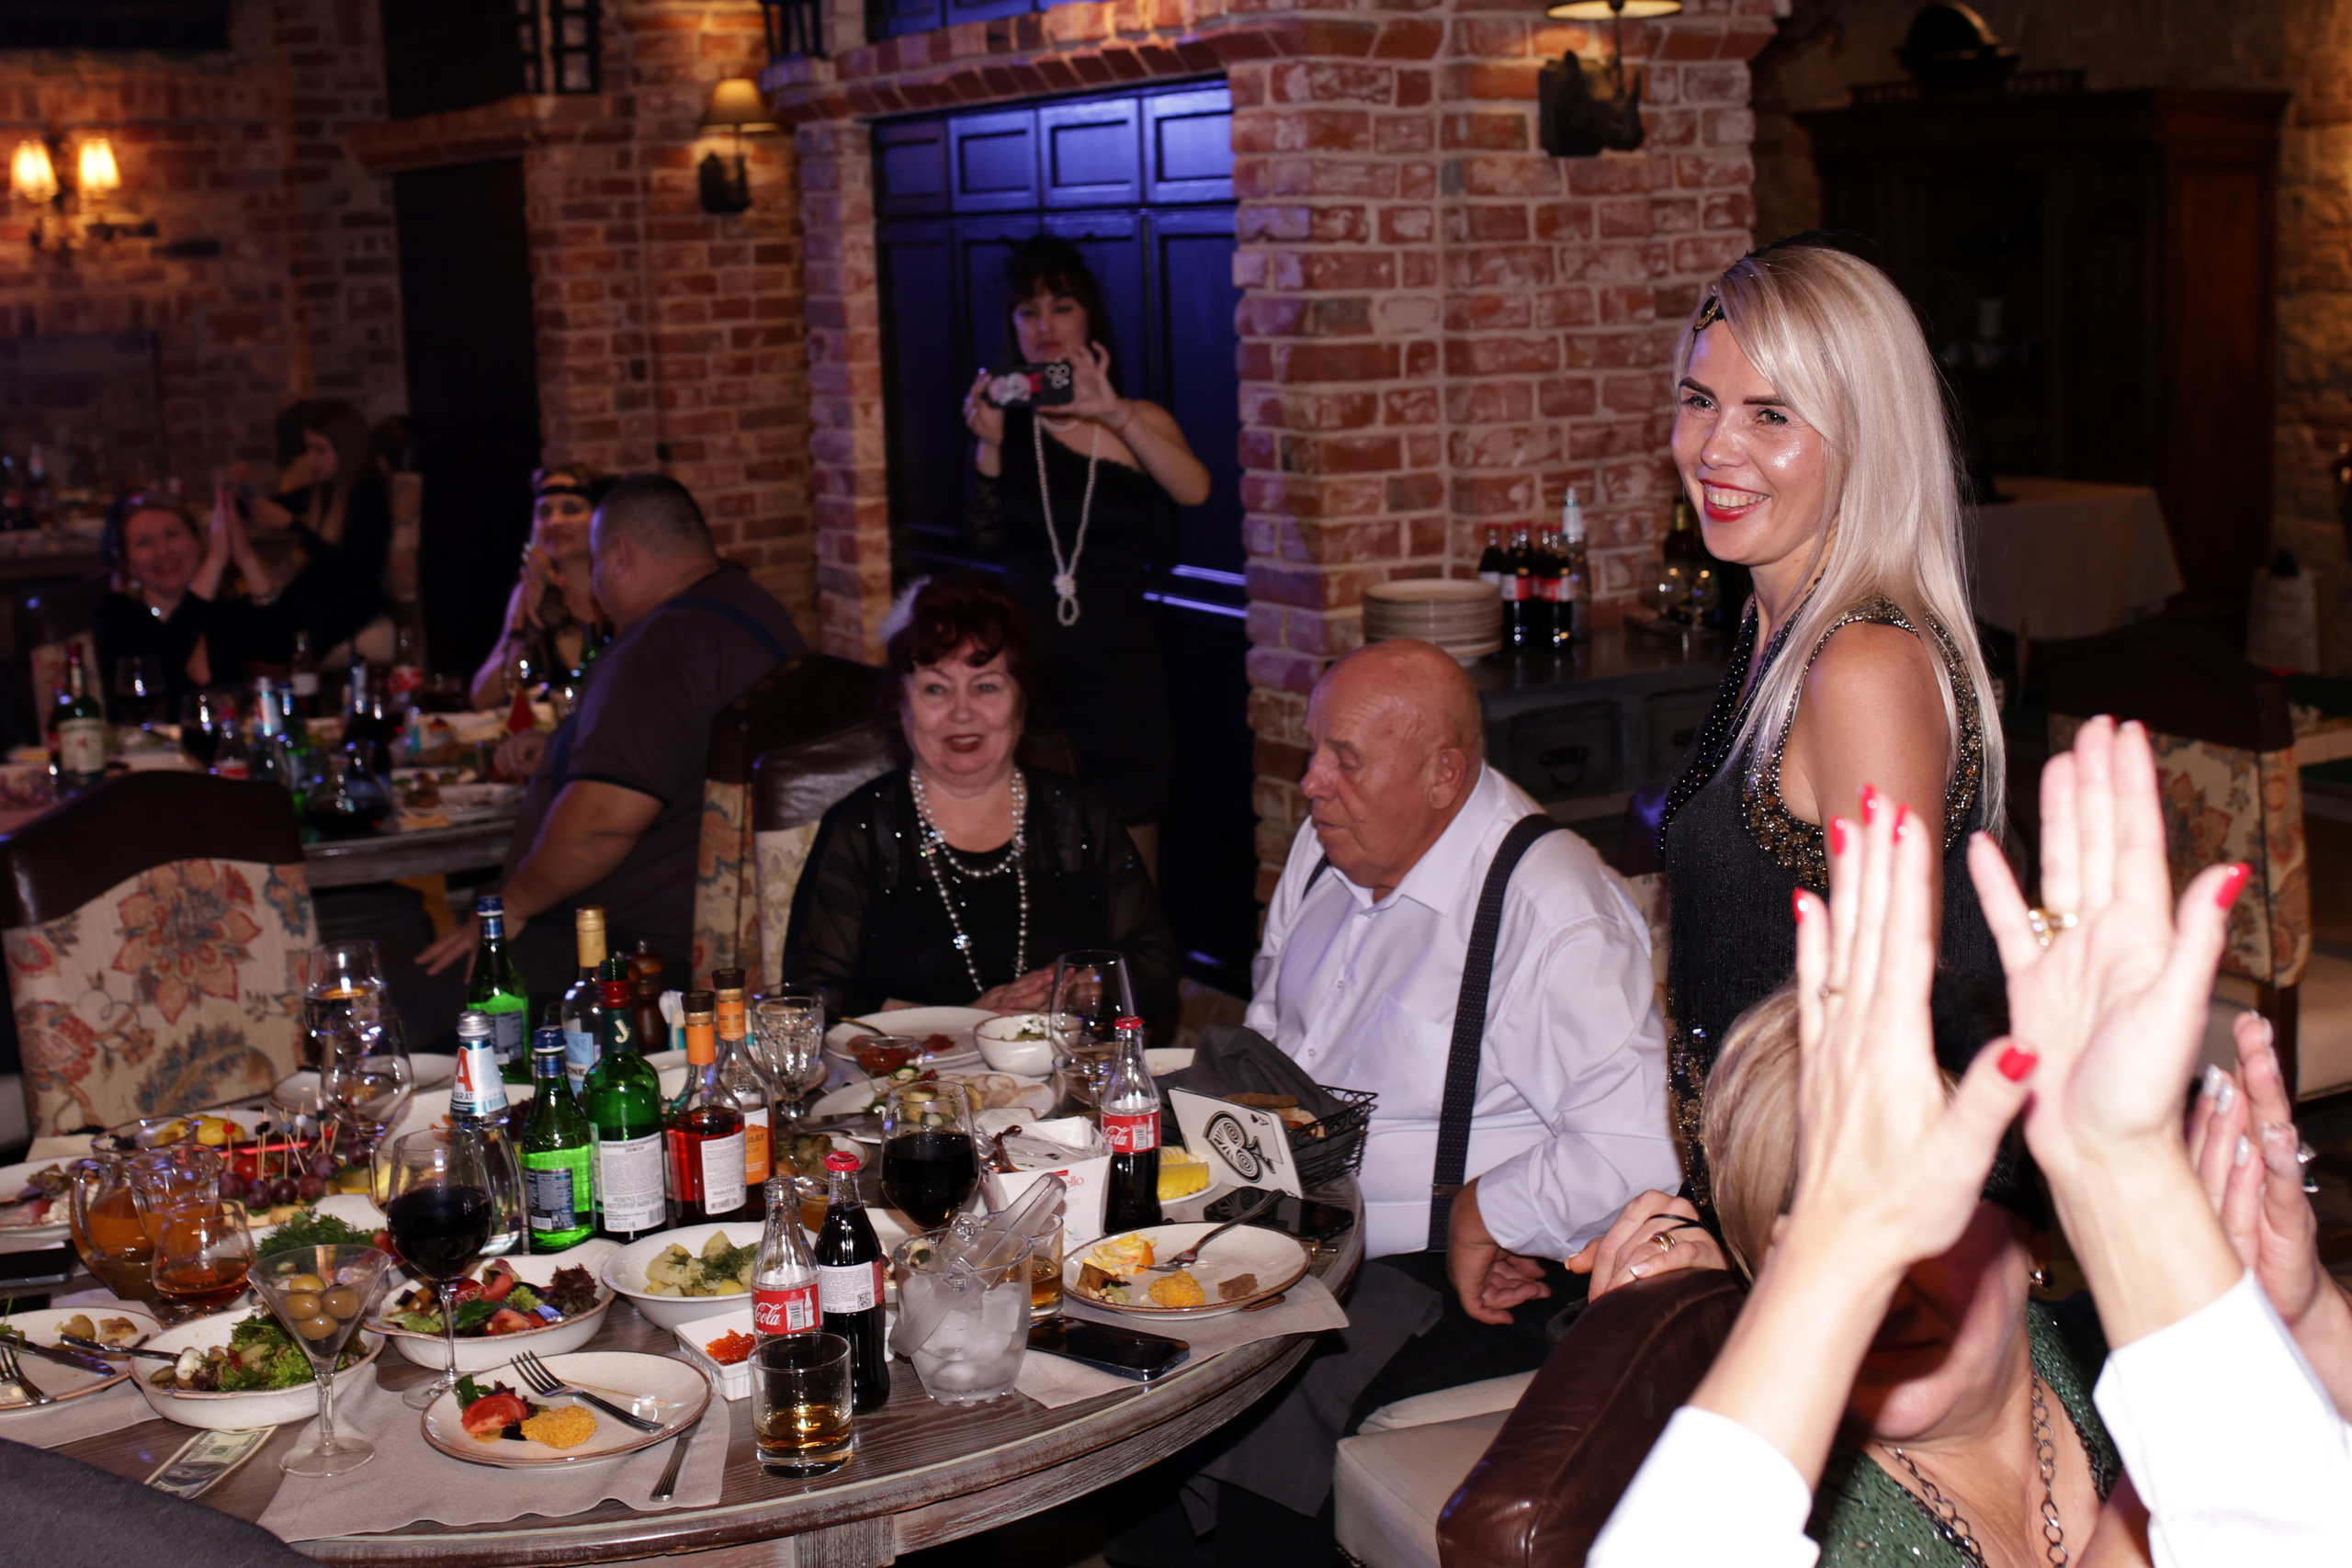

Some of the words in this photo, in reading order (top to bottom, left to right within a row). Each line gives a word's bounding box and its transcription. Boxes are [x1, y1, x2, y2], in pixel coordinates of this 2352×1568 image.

[615, 1019, 629, 1043] J
[456, 1047, 474, 1091] A
[747, 1133, 764, 1144] RAT
[1066, 1176, 1084, 1188] ello
[754, 1302, 784, 1325] Cola
